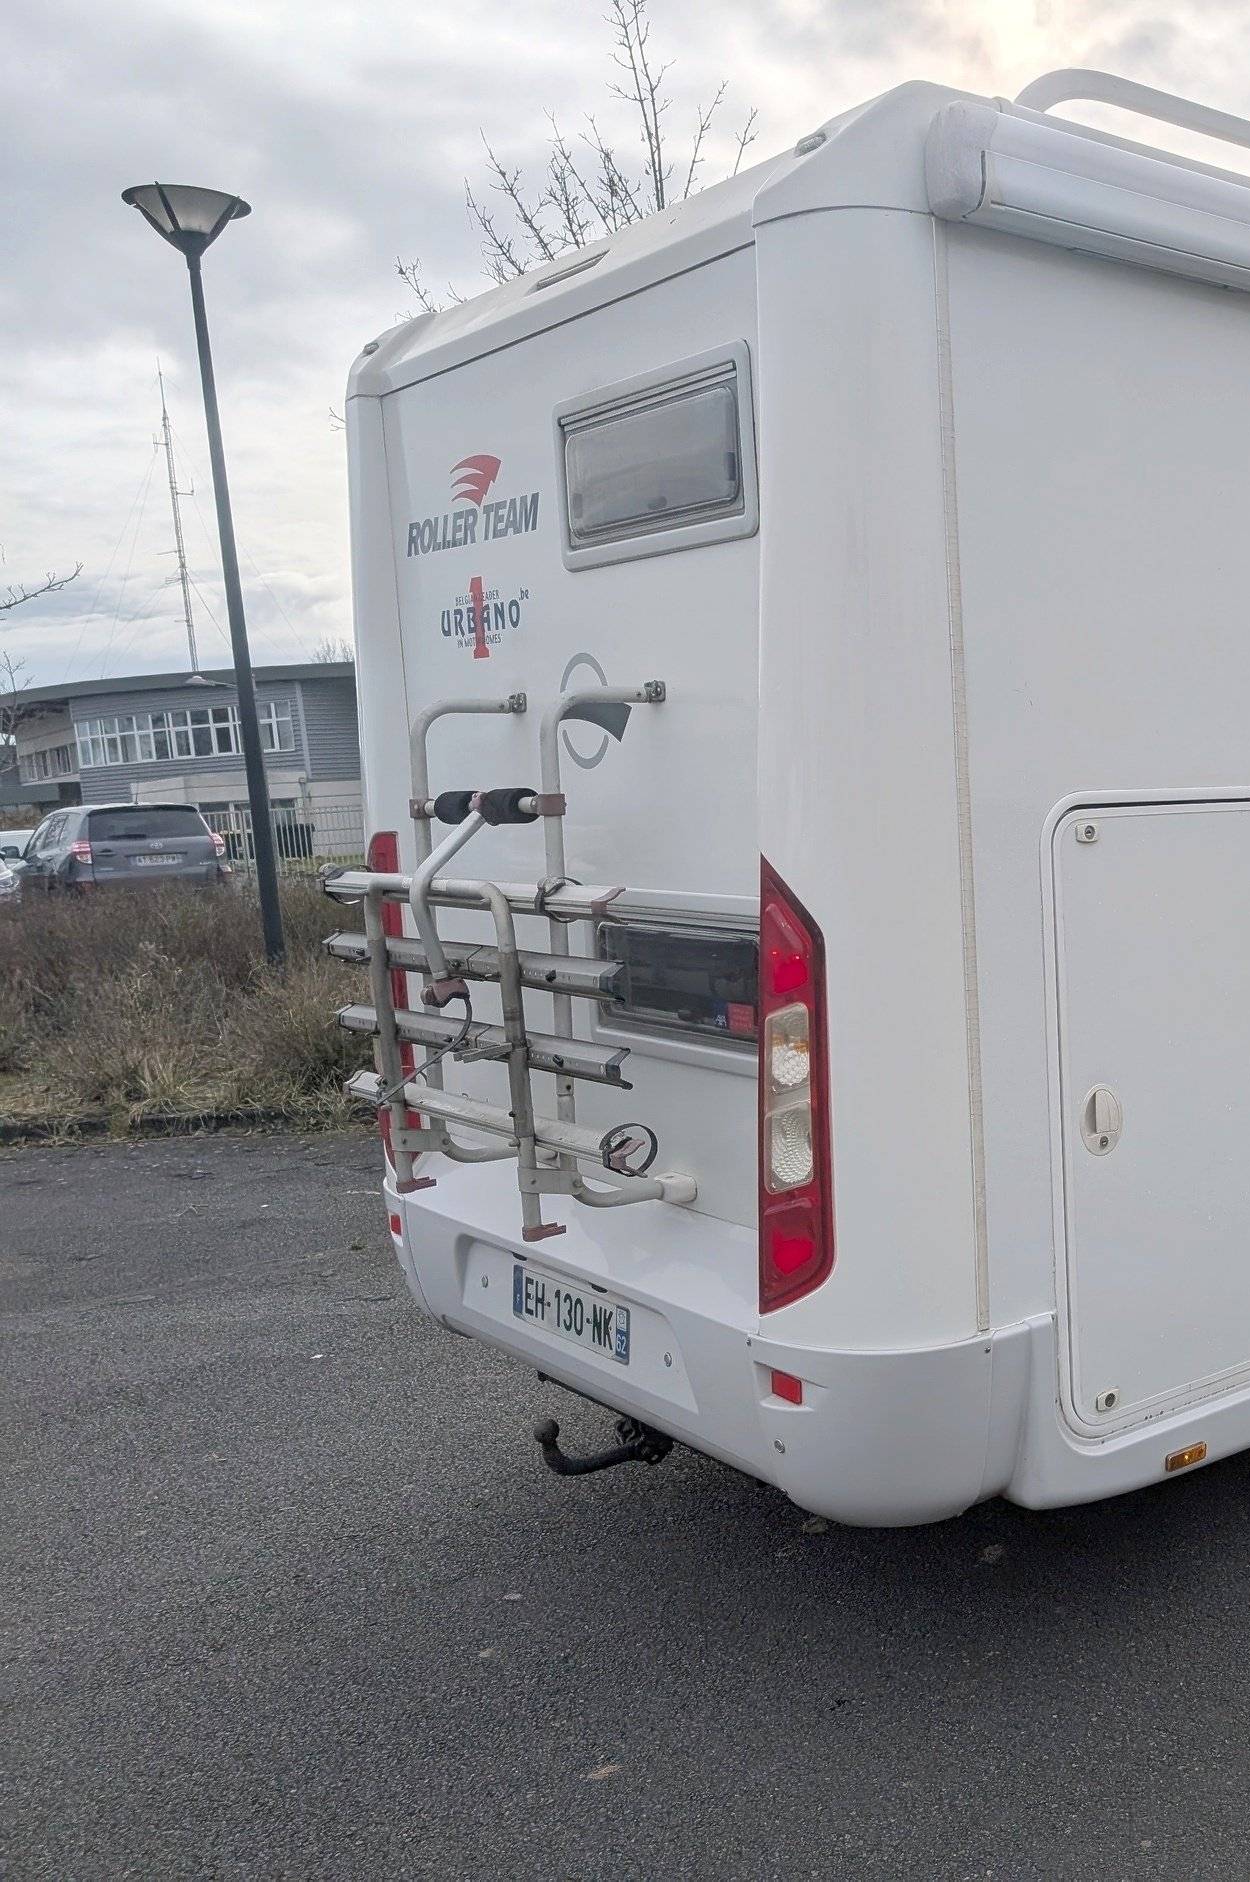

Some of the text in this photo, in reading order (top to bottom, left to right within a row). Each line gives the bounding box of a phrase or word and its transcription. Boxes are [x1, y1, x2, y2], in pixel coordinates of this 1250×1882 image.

[407, 491, 539, 558] ROLLER TEAM
[441, 599, 520, 637] URBANO
[524, 1276, 614, 1350] EH-130-NK
[616, 1334, 627, 1355] 62
